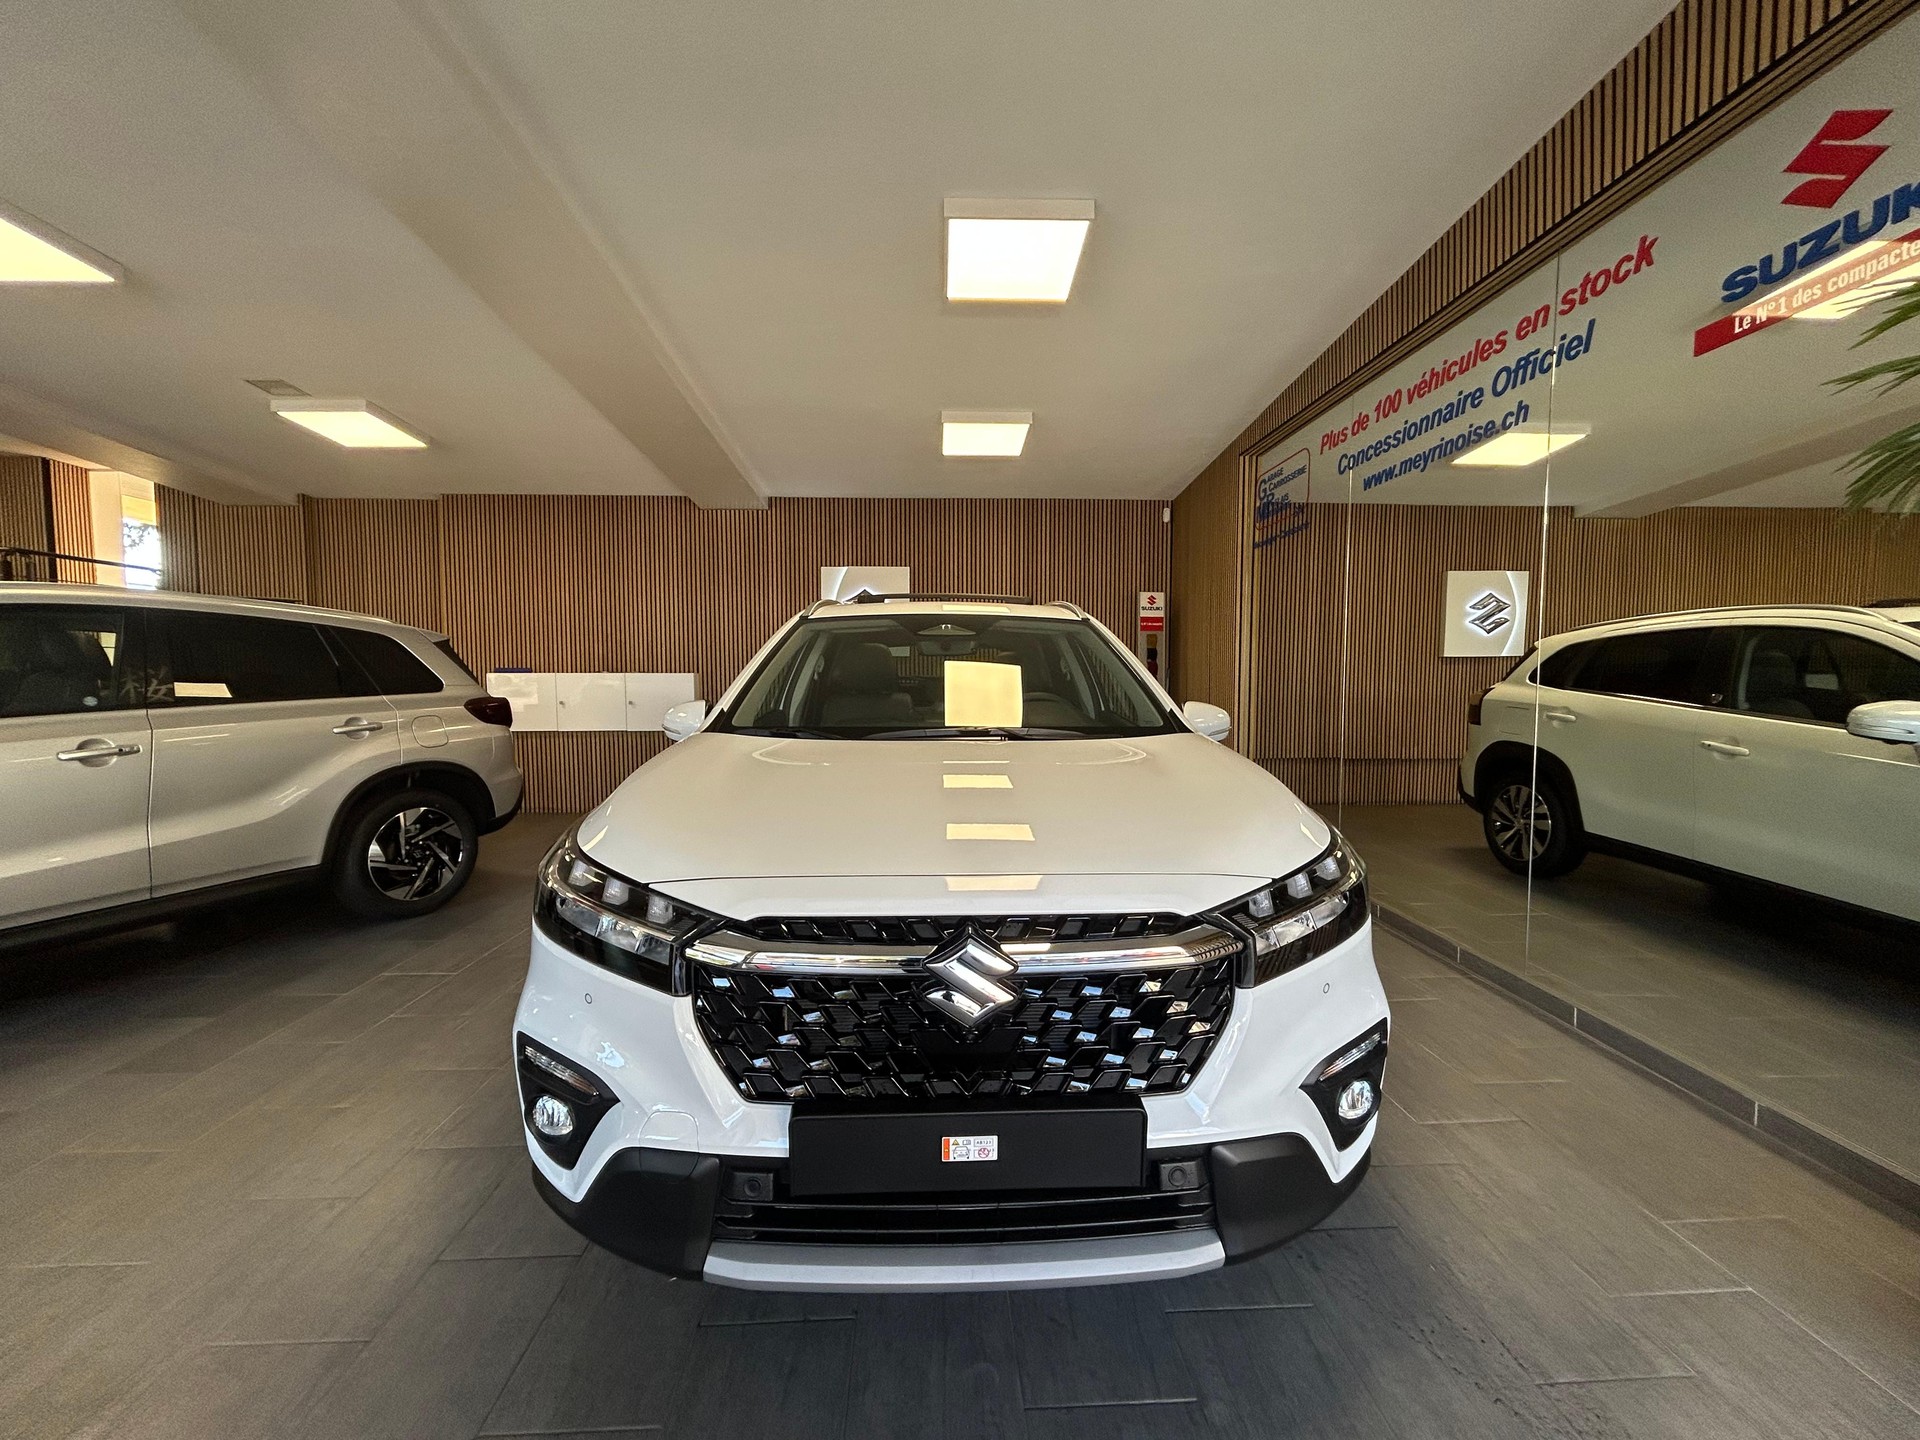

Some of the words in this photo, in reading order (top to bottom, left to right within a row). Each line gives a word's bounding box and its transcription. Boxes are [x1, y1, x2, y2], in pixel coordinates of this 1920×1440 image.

[1721, 182, 1920, 303] SUZUK
[1733, 315, 1752, 334] Le
[1792, 283, 1823, 308] des
[1827, 239, 1920, 293] compacte
[1319, 426, 1349, 455] Plus
[1350, 411, 1370, 437] de
[1374, 388, 1403, 423] 100
[1406, 328, 1508, 405] véhicules
[1514, 303, 1551, 342] en
[1558, 233, 1659, 316] stock
[1337, 386, 1485, 476] Concessionnaire
[1491, 317, 1597, 398] Officiel
[1362, 399, 1530, 492] www.meyrinoise.ch
